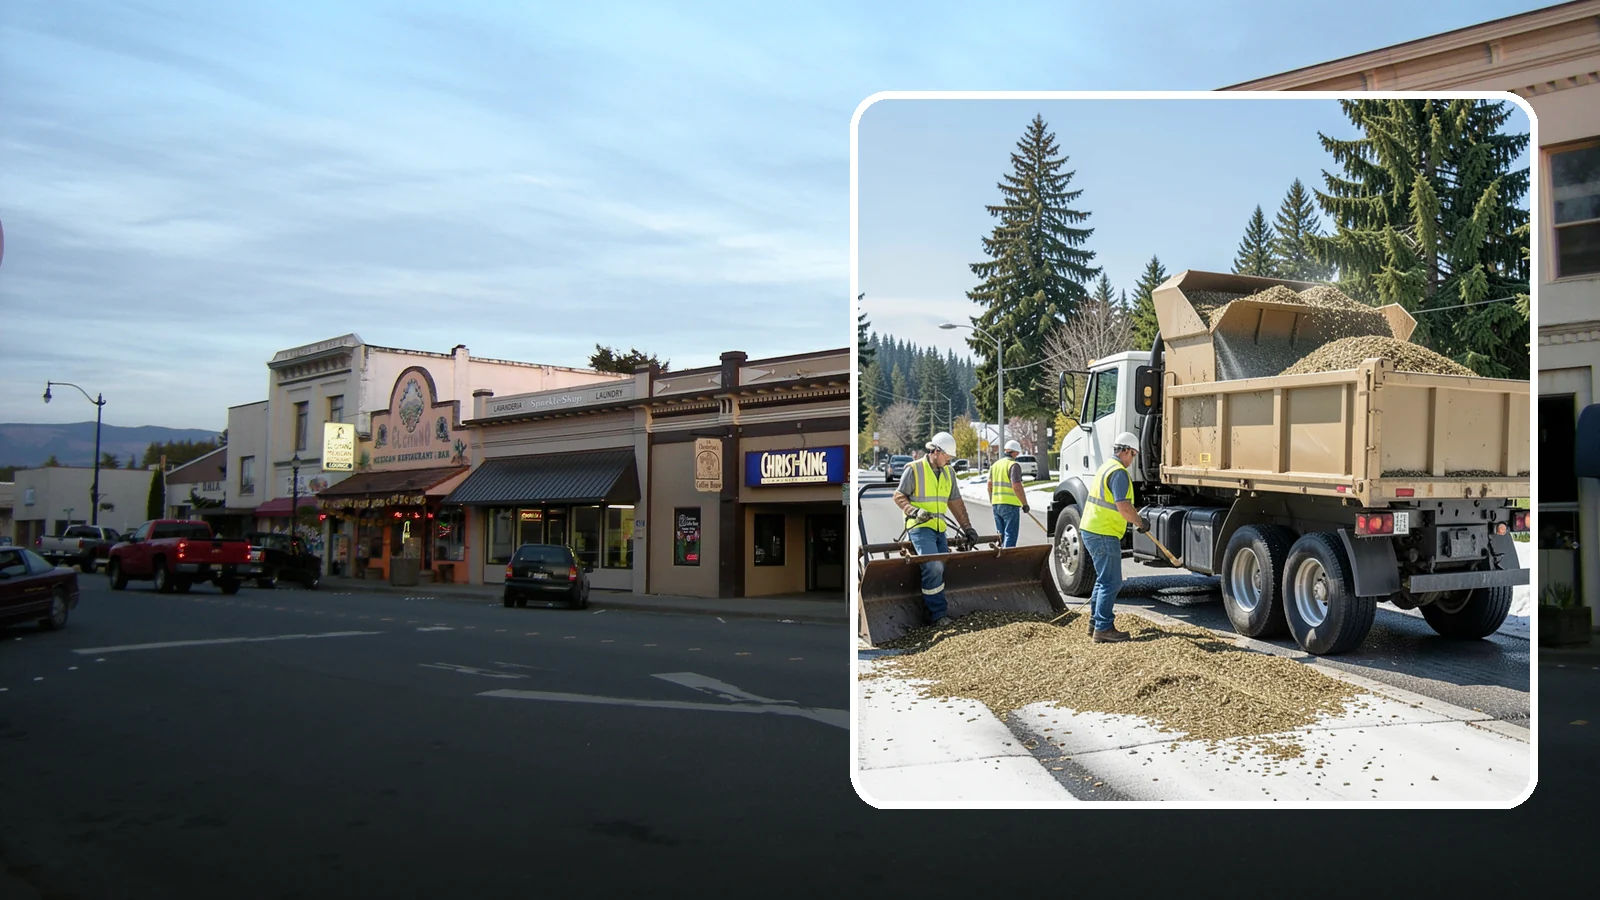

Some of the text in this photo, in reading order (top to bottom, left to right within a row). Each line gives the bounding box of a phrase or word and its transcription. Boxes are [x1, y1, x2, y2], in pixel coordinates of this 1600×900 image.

[595, 389, 623, 400] LAUNDRY
[493, 401, 523, 413] LAVANDERIA
[530, 395, 582, 409] Sparkle Shop
[374, 450, 450, 464] MEXICAN RESTAURANT BAR
